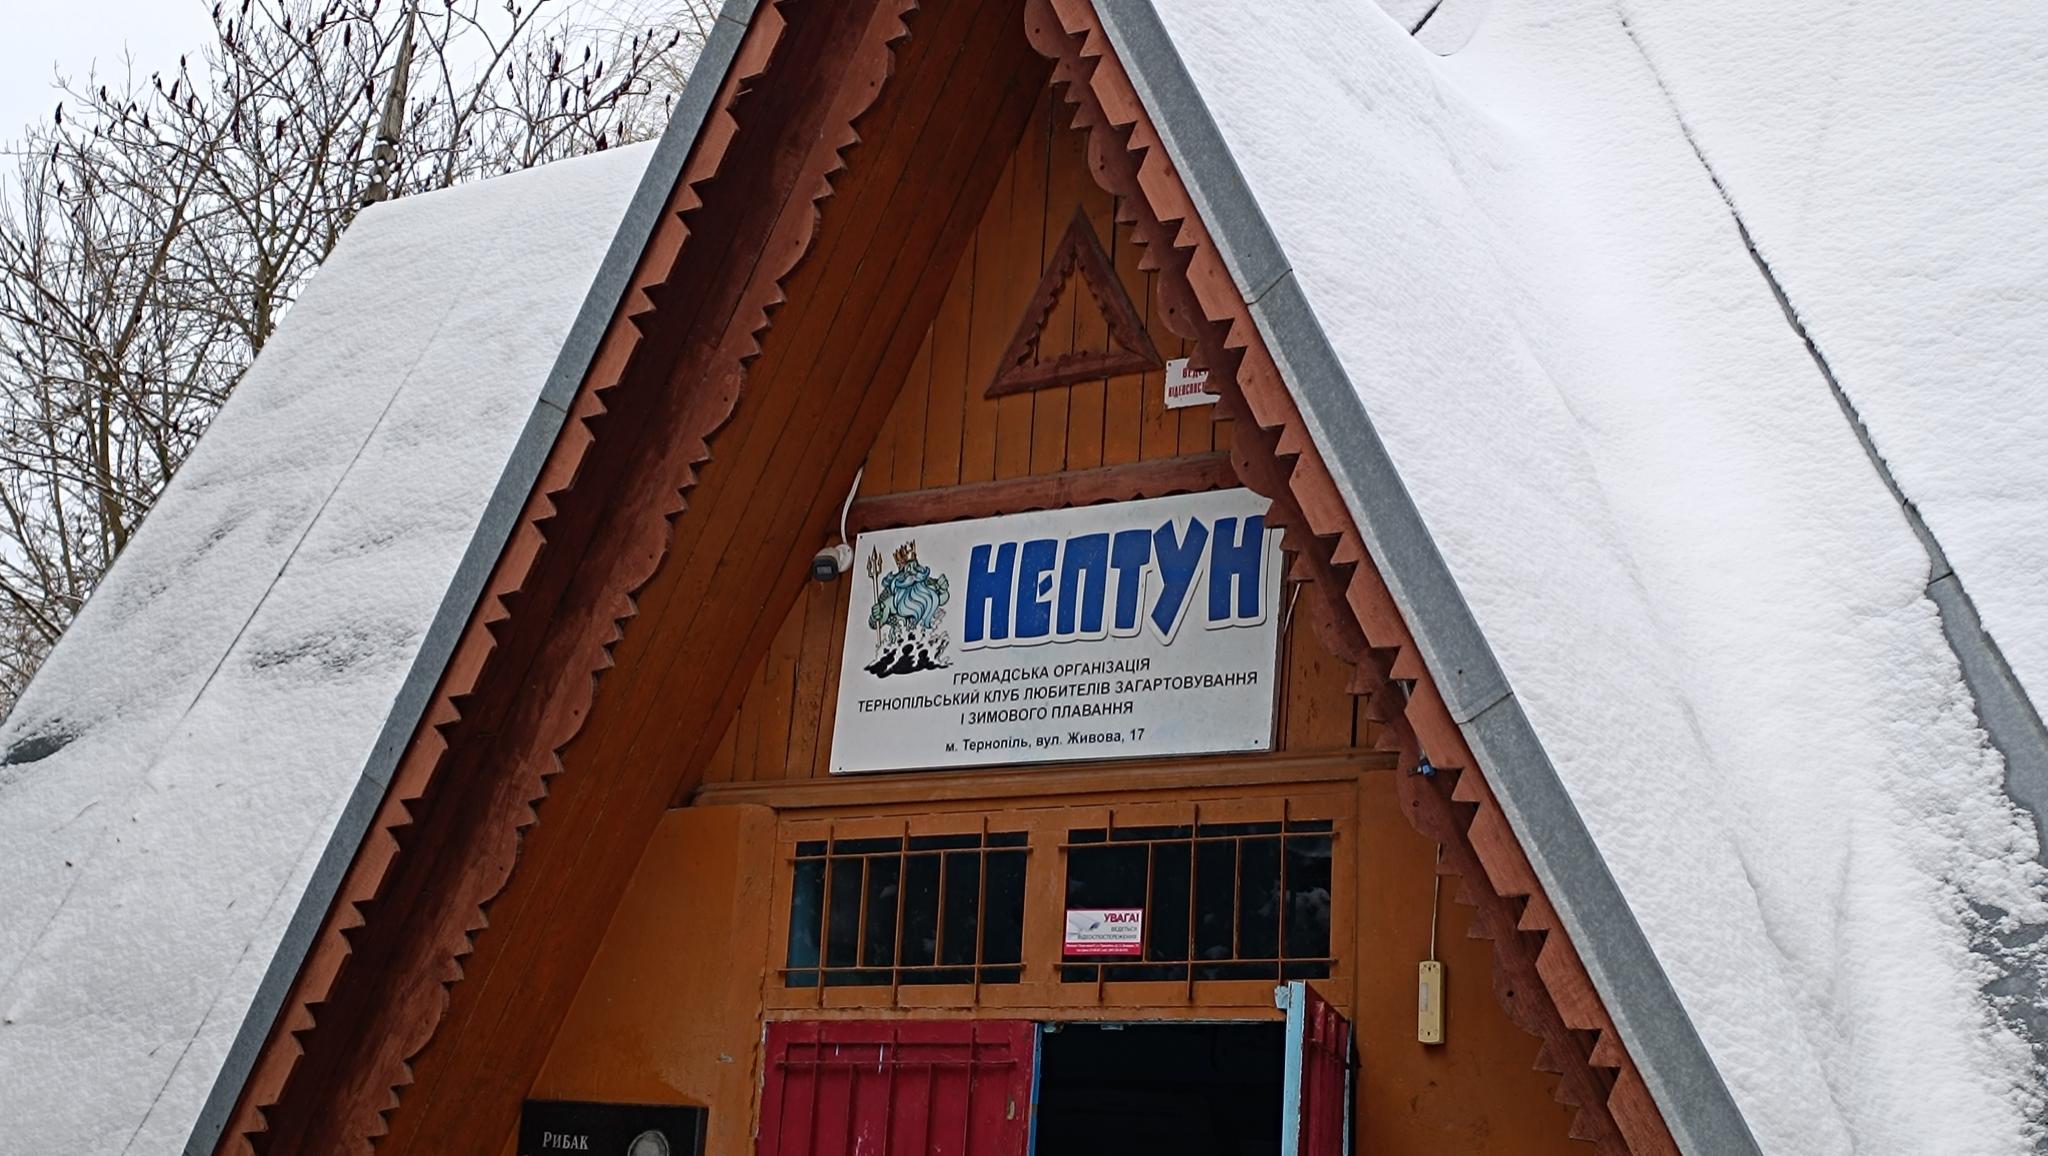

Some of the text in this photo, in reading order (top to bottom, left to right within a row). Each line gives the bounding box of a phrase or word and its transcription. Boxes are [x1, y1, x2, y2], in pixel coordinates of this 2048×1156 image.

[1182, 367, 1206, 378] ВЕД
[1168, 382, 1205, 397] ВІДЕОСПОС
[963, 514, 1265, 643] НЕПТУН
[953, 657, 1151, 685] ГРОМАДСЬКА ОРГАНІЗАЦІЯ
[858, 671, 1258, 712] ТЕРНОПІЛЬСЬКИЙ КЛУБ ЛЮБИТЕЛІВ ЗАГАРТОВУВАННЯ
[960, 701, 1133, 725] І ЗИМОВОГО ПЛАВАННЯ
[945, 728, 1145, 753] м. Тернопіль, вул. Живова, 17
[1103, 912, 1139, 923] УВАГА!
[542, 1131, 589, 1150] РИБАК
